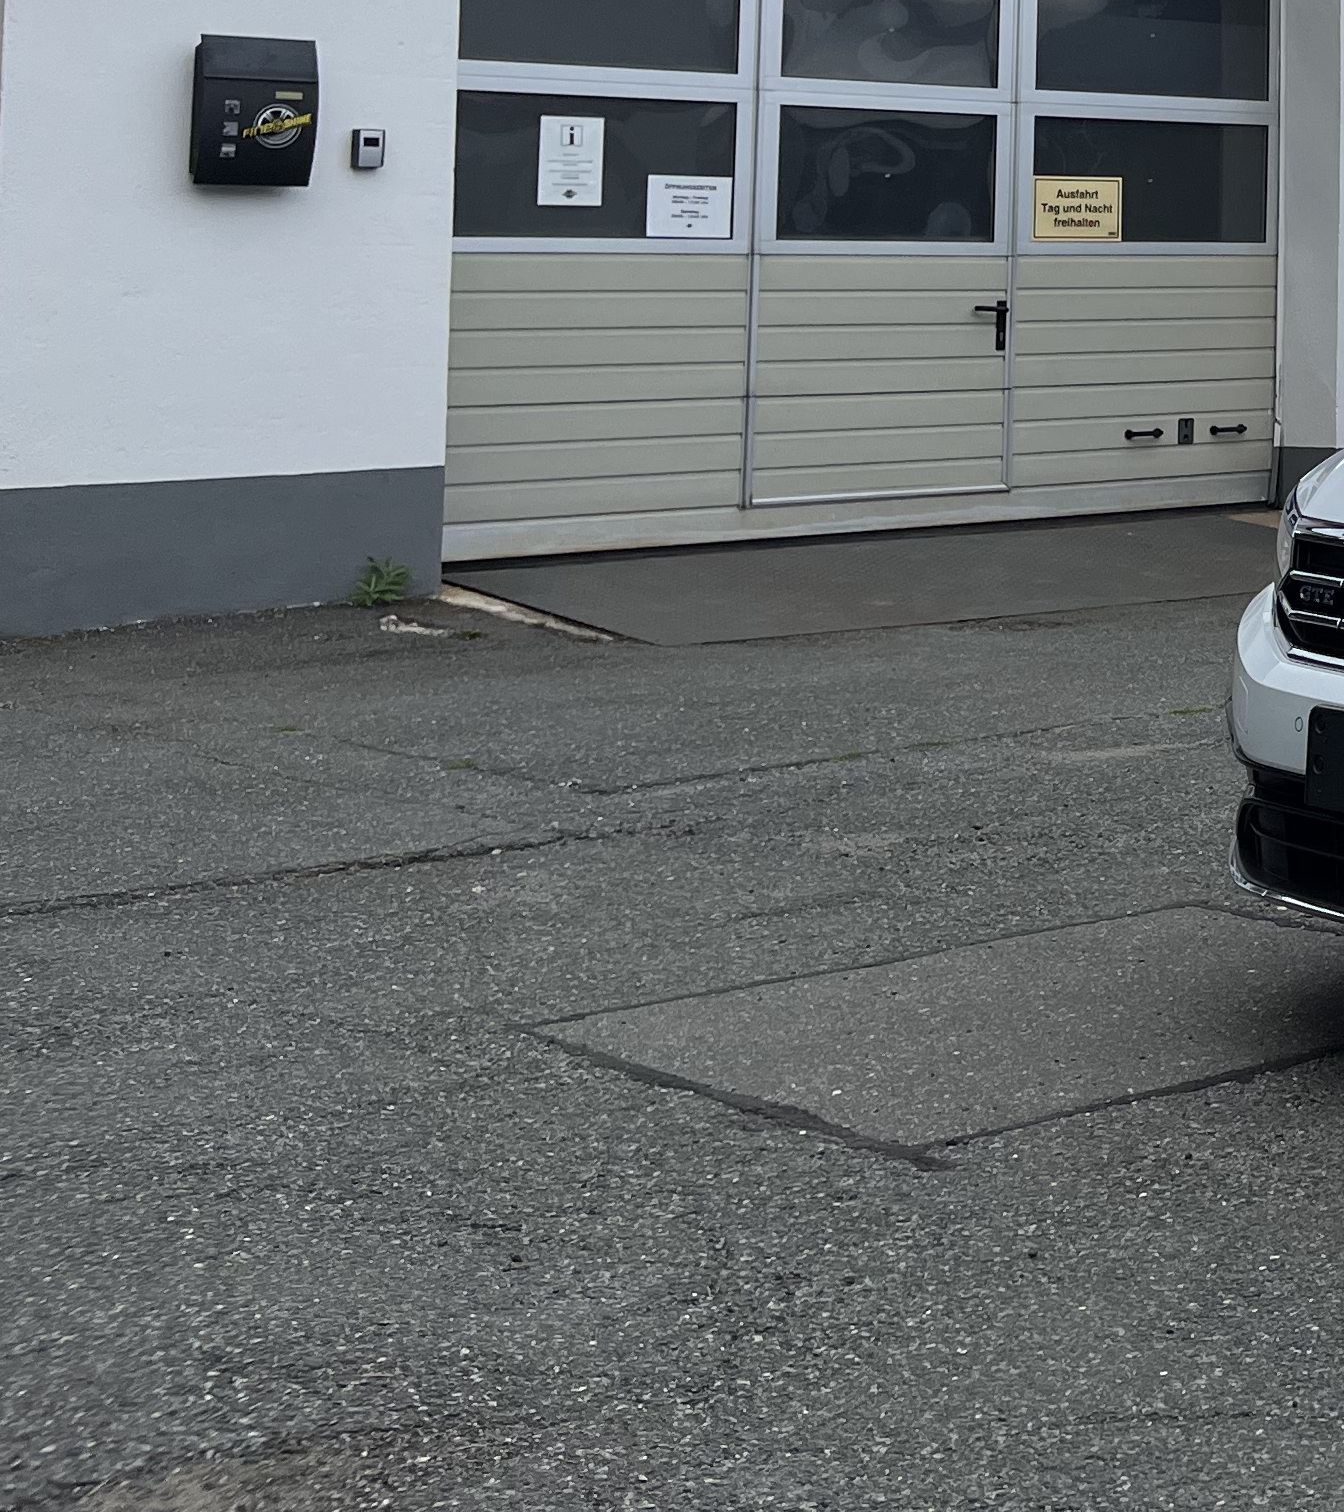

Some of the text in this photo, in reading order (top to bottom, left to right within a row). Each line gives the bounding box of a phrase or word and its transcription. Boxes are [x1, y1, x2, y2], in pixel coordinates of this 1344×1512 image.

[1056, 188, 1099, 200] Ausfahrt
[1041, 202, 1113, 215] Tag und Nacht
[1053, 217, 1101, 228] freihalten
[1299, 584, 1335, 606] GTE
